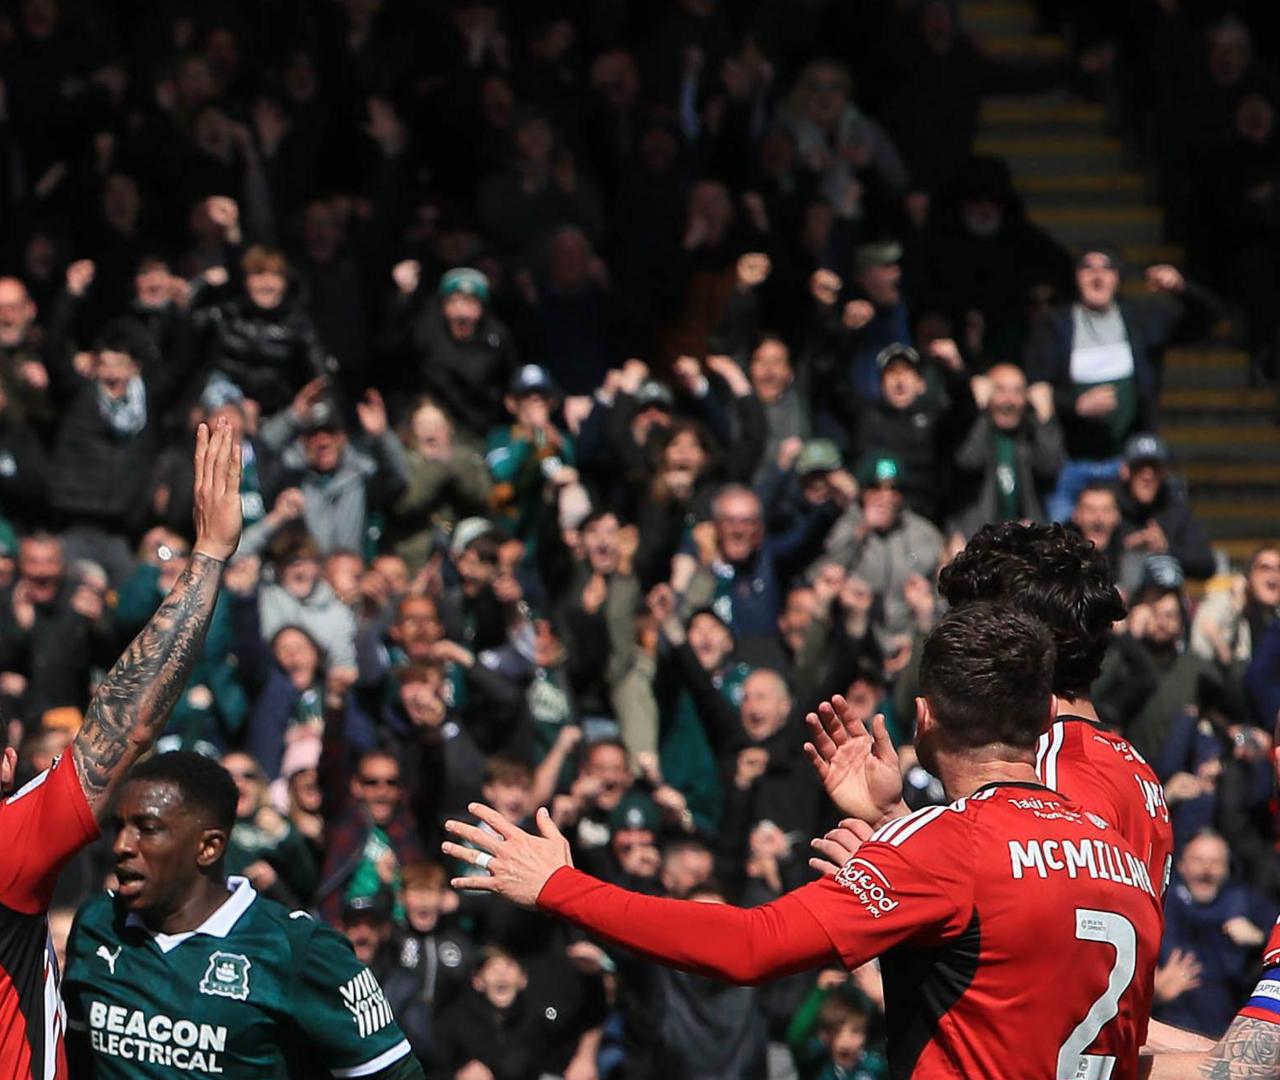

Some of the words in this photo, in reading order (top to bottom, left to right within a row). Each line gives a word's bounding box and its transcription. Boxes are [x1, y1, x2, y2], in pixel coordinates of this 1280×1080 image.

[1008, 839, 1157, 898] MCMILLAN
[90, 1001, 227, 1052] BEACON
[91, 1029, 223, 1073] ELECTRICAL
